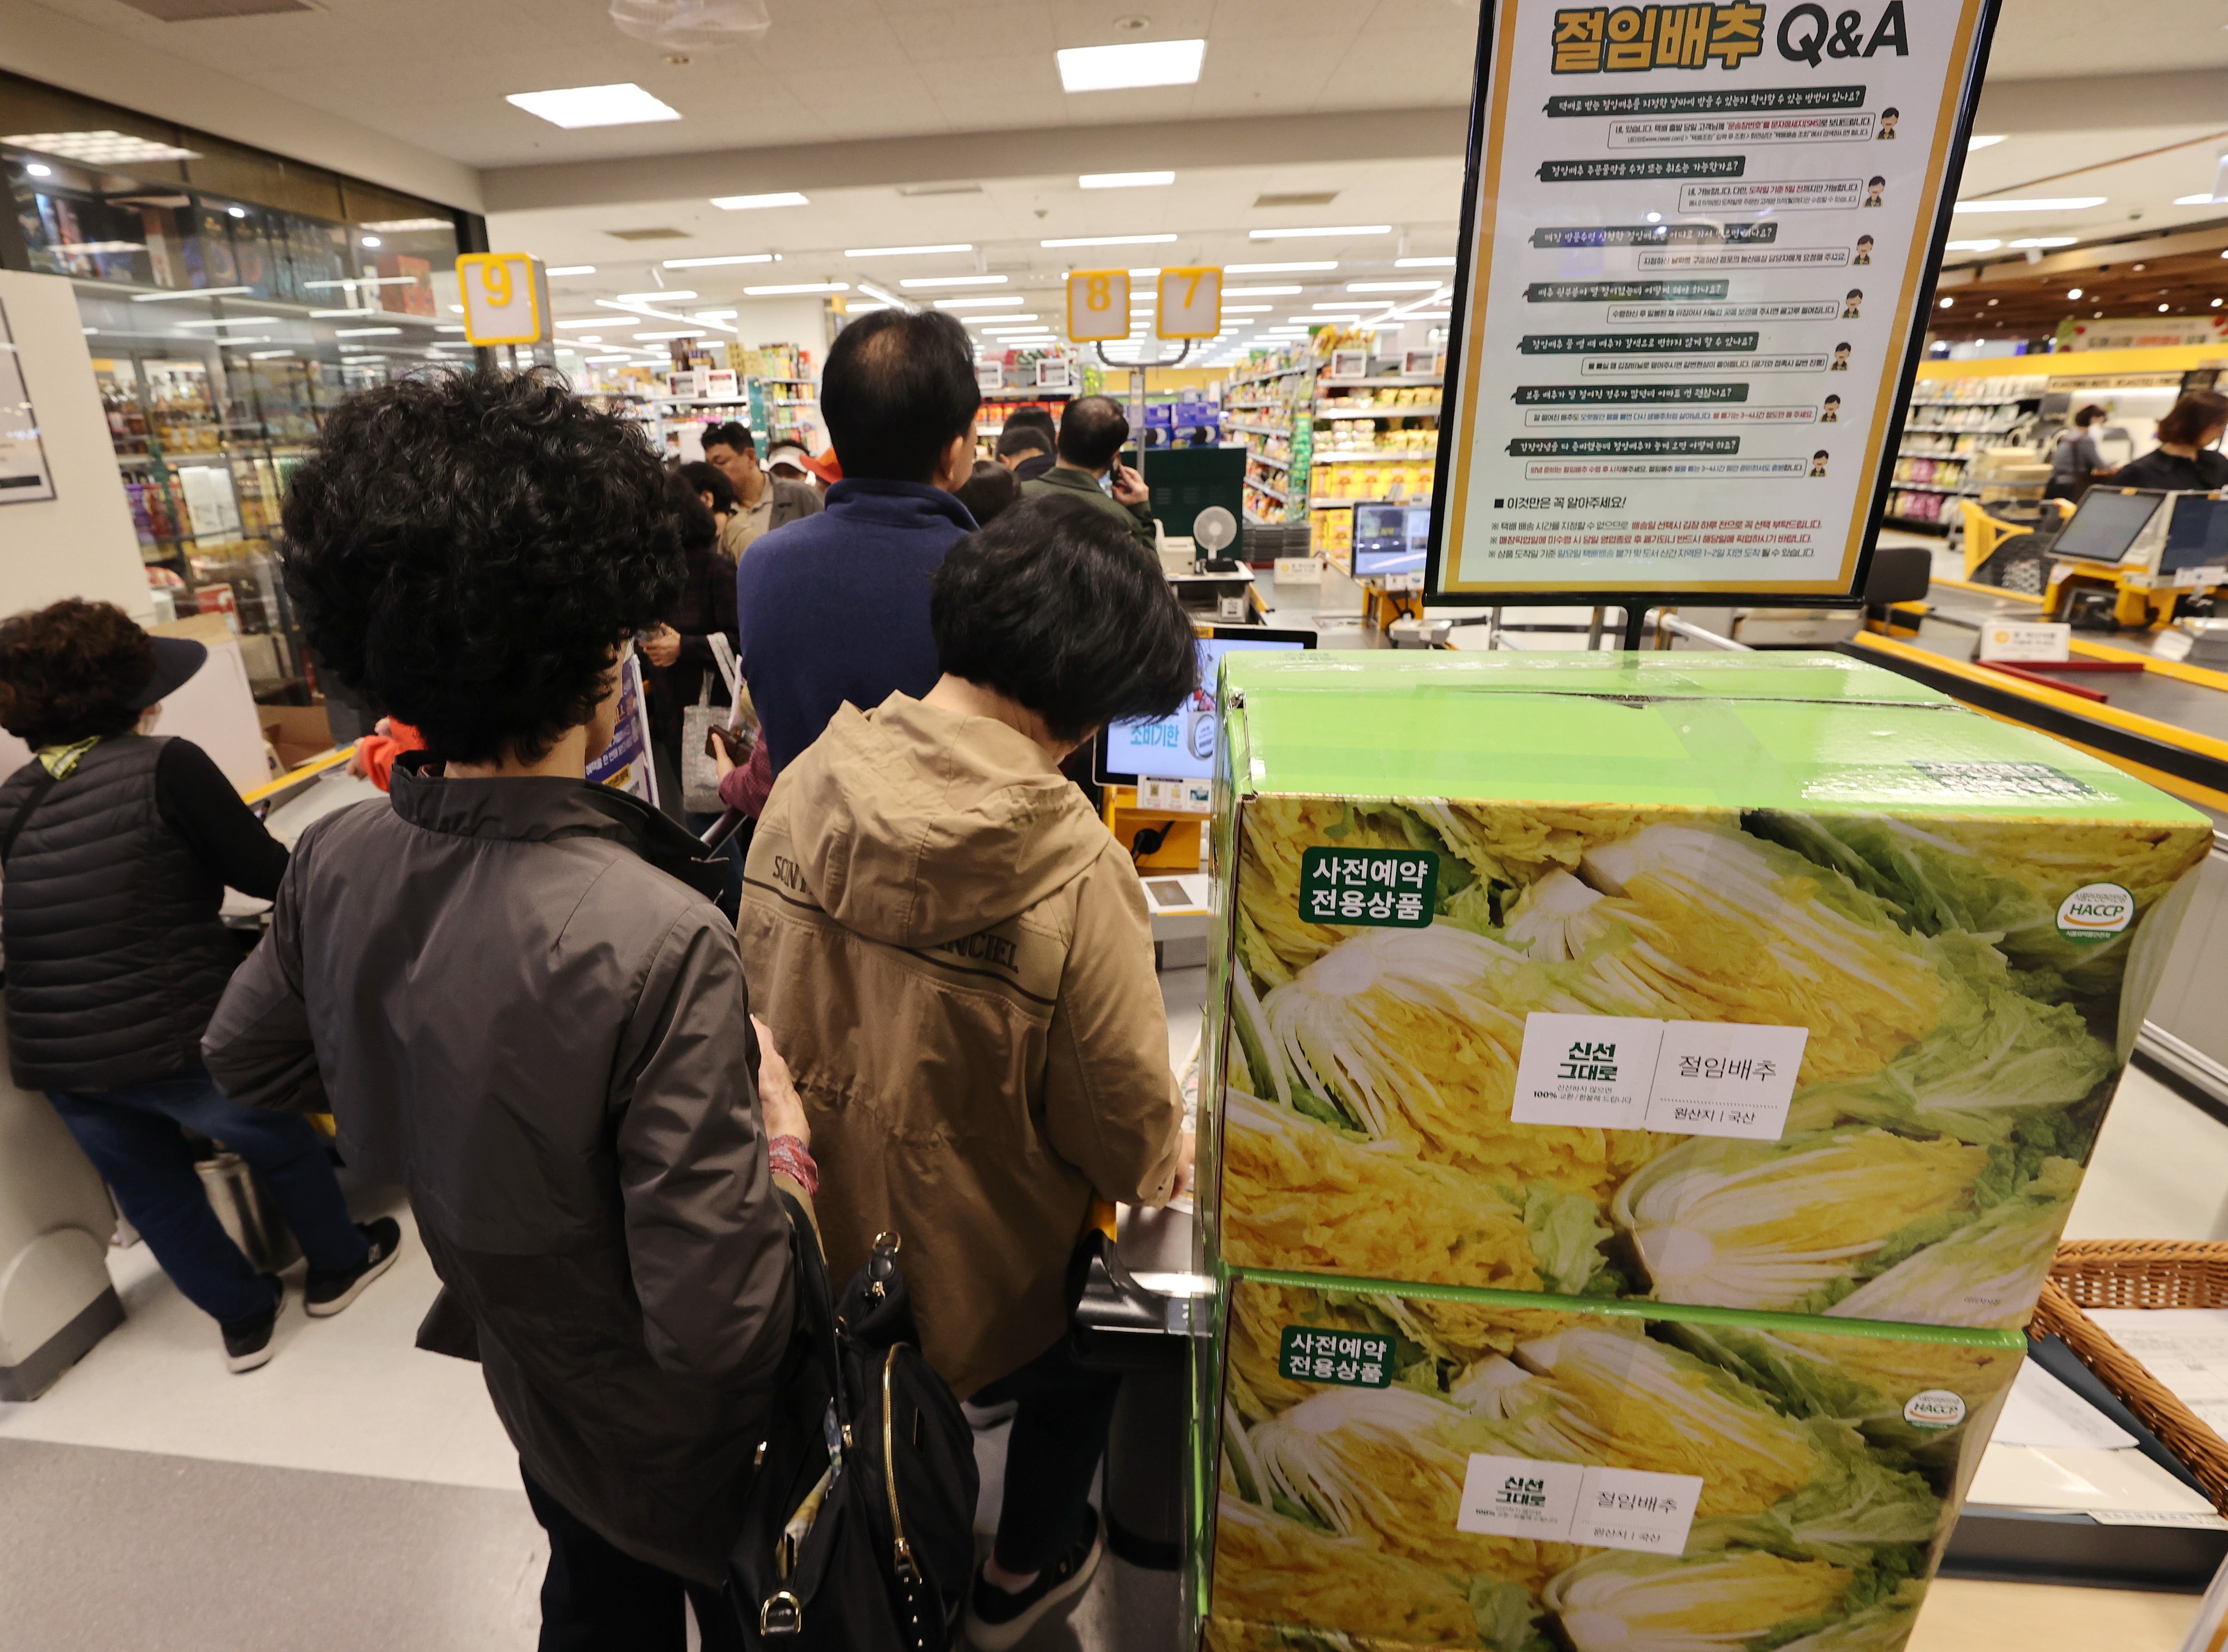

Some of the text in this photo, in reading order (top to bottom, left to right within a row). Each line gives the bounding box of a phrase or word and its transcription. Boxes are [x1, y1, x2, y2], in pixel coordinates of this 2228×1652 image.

[1552, 0, 1909, 73] 절임배추 Q&A
[1585, 99, 1600, 111] 받는
[1643, 97, 1667, 108] 지정한
[1698, 96, 1713, 107] 받을
[1716, 95, 1722, 107] 수
[1725, 95, 1748, 106] 있는지
[1751, 94, 1775, 105] 확인할
[1778, 93, 1784, 105] 수
[1787, 93, 1802, 104] 있는
[1805, 92, 1829, 104] 방법이
[1832, 91, 1860, 103] 있나요?
[1629, 163, 1645, 175] 수정
[1648, 162, 1662, 175] 또는
[1666, 162, 1689, 174] 취소는
[1693, 161, 1738, 173] 가능한가요?
[1749, 186, 1768, 194] 도착일
[482, 258, 513, 306] 9
[1178, 274, 1202, 308] 7
[1693, 283, 1721, 294] 하나요?
[1087, 276, 1111, 312] 8
[1716, 336, 1722, 348] 수
[1725, 336, 1753, 347] 있나요?
[1507, 497, 1627, 509] 이것만은 꼭 알아주세요!
[1501, 522, 1517, 531] 택배
[1519, 522, 1534, 531] 배송
[1561, 522, 1585, 530] 지정할
[1587, 522, 1594, 530] 수
[1597, 521, 1628, 530] 없으므로
[1632, 521, 1656, 530] 배송일
[1657, 521, 1682, 530] 선택시
[1684, 521, 1699, 529] 김장
[1701, 521, 1717, 529] 하루
[1719, 520, 1743, 529] 전으로
[1745, 520, 1753, 529] 꼭
[1754, 520, 1771, 529] 선택
[1772, 520, 1822, 529] 부탁드립니다.
[1499, 534, 1812, 545] 매장픽업일에 미수령 시 당일 영업종료 후 폐기되니 반드시 해당일에 픽업하시기 바랍니다.
[1498, 549, 1513, 559] 상품
[1515, 549, 1538, 559] 도착일
[1540, 549, 1556, 559] 기준
[1558, 549, 1581, 558] 일요일
[1583, 549, 1614, 558] 택배배송
[1615, 549, 1632, 558] 불가
[1643, 549, 1659, 558] 도서
[1660, 548, 1676, 558] 산간
[1678, 548, 1702, 558] 지역은
[1726, 548, 1742, 558] 지연
[1744, 548, 1760, 557] 도착
[1772, 548, 1779, 557] 수
[1782, 548, 1814, 557] 있습니다.
[1130, 725, 1179, 747] 소비기한
[1313, 857, 1428, 889] 사전예약
[1311, 889, 1423, 920] 전용상품
[2070, 904, 2124, 916] HACCP
[1569, 1041, 1616, 1062] 신선
[1557, 1062, 1617, 1082] 그대로
[1679, 1055, 1776, 1081] 절임배추
[1533, 1090, 1557, 1099] 100%
[1557, 1084, 1612, 1094] 신선하지 않으면
[1674, 1107, 1755, 1125] 원산지 국산
[1291, 1333, 1387, 1362] 사전예약
[1290, 1355, 1383, 1384] 전용상품
[1915, 1402, 1958, 1415] HACCP
[1505, 1476, 1543, 1493] 신선
[1495, 1490, 1546, 1508] 그대로
[1597, 1490, 1677, 1514] 절임배추
